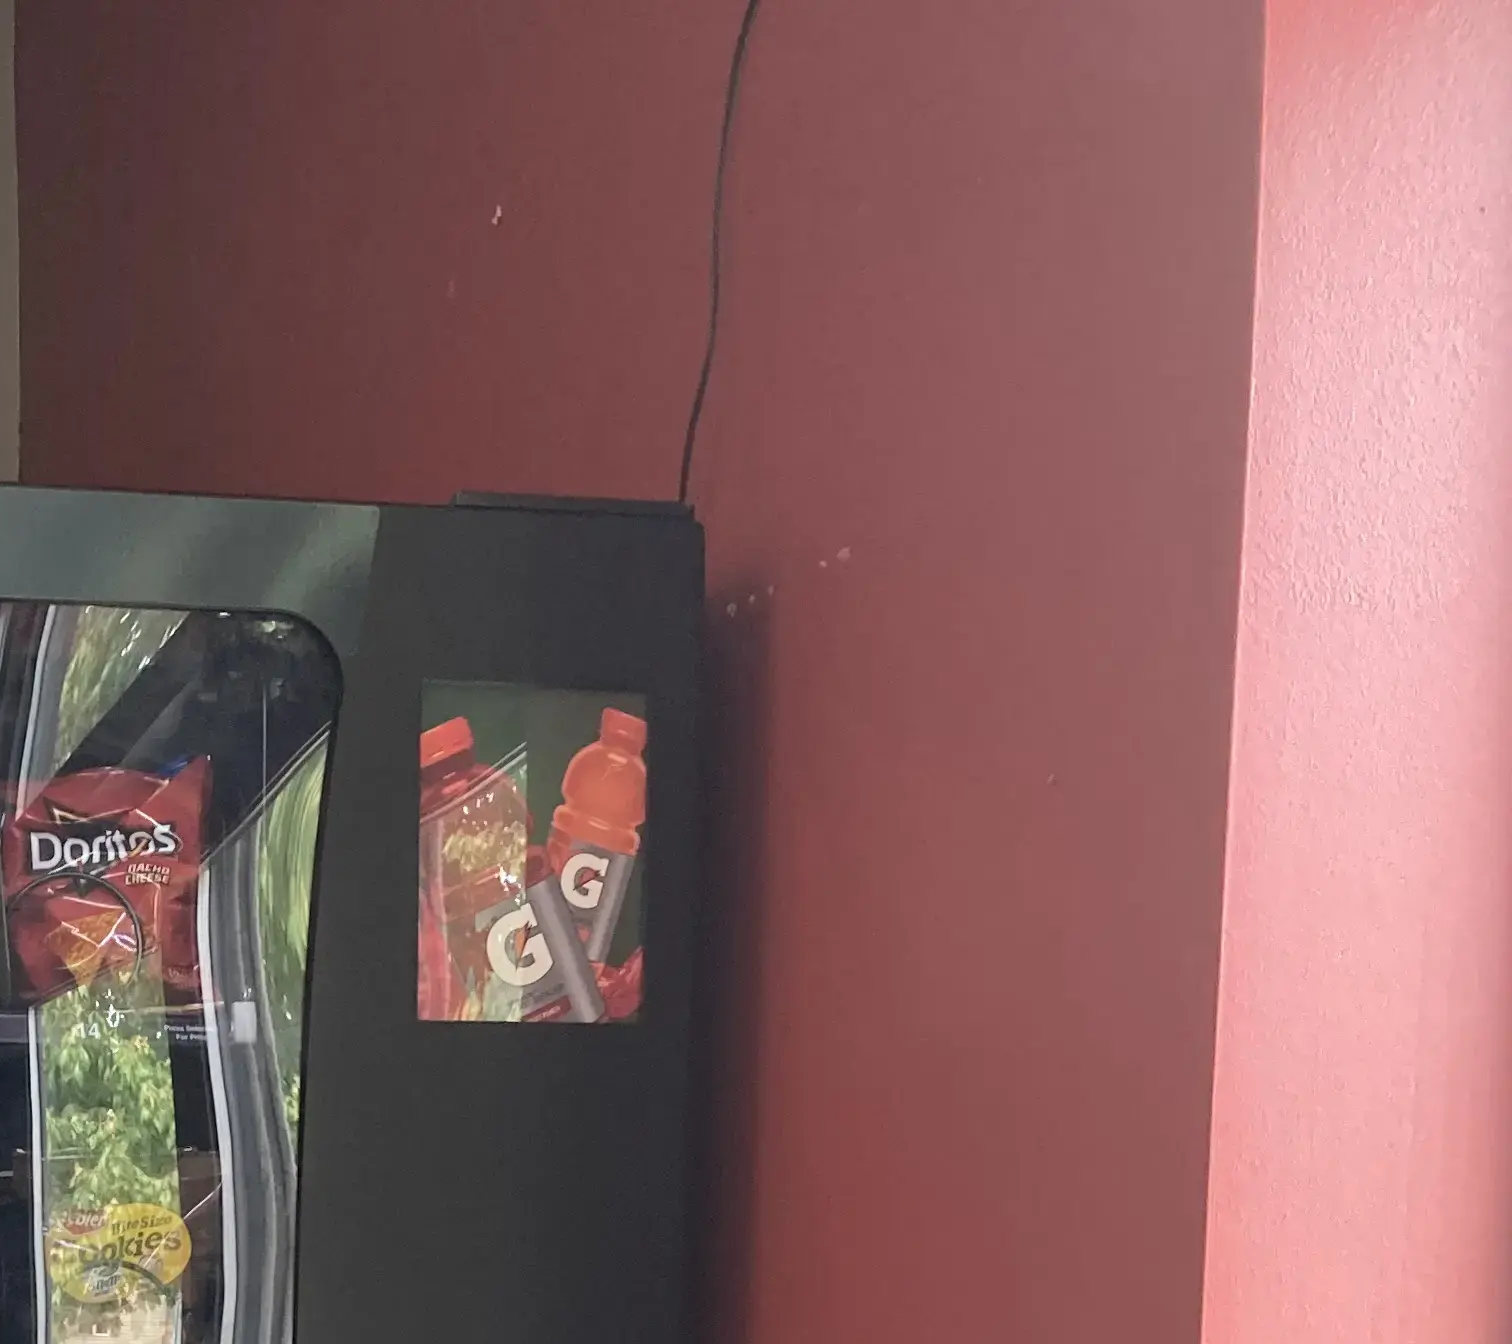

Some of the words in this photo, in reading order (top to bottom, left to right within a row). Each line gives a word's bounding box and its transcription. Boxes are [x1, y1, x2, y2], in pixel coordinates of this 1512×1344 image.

[30, 824, 177, 870] Doritos
[561, 853, 610, 909] G
[487, 903, 554, 987] G
